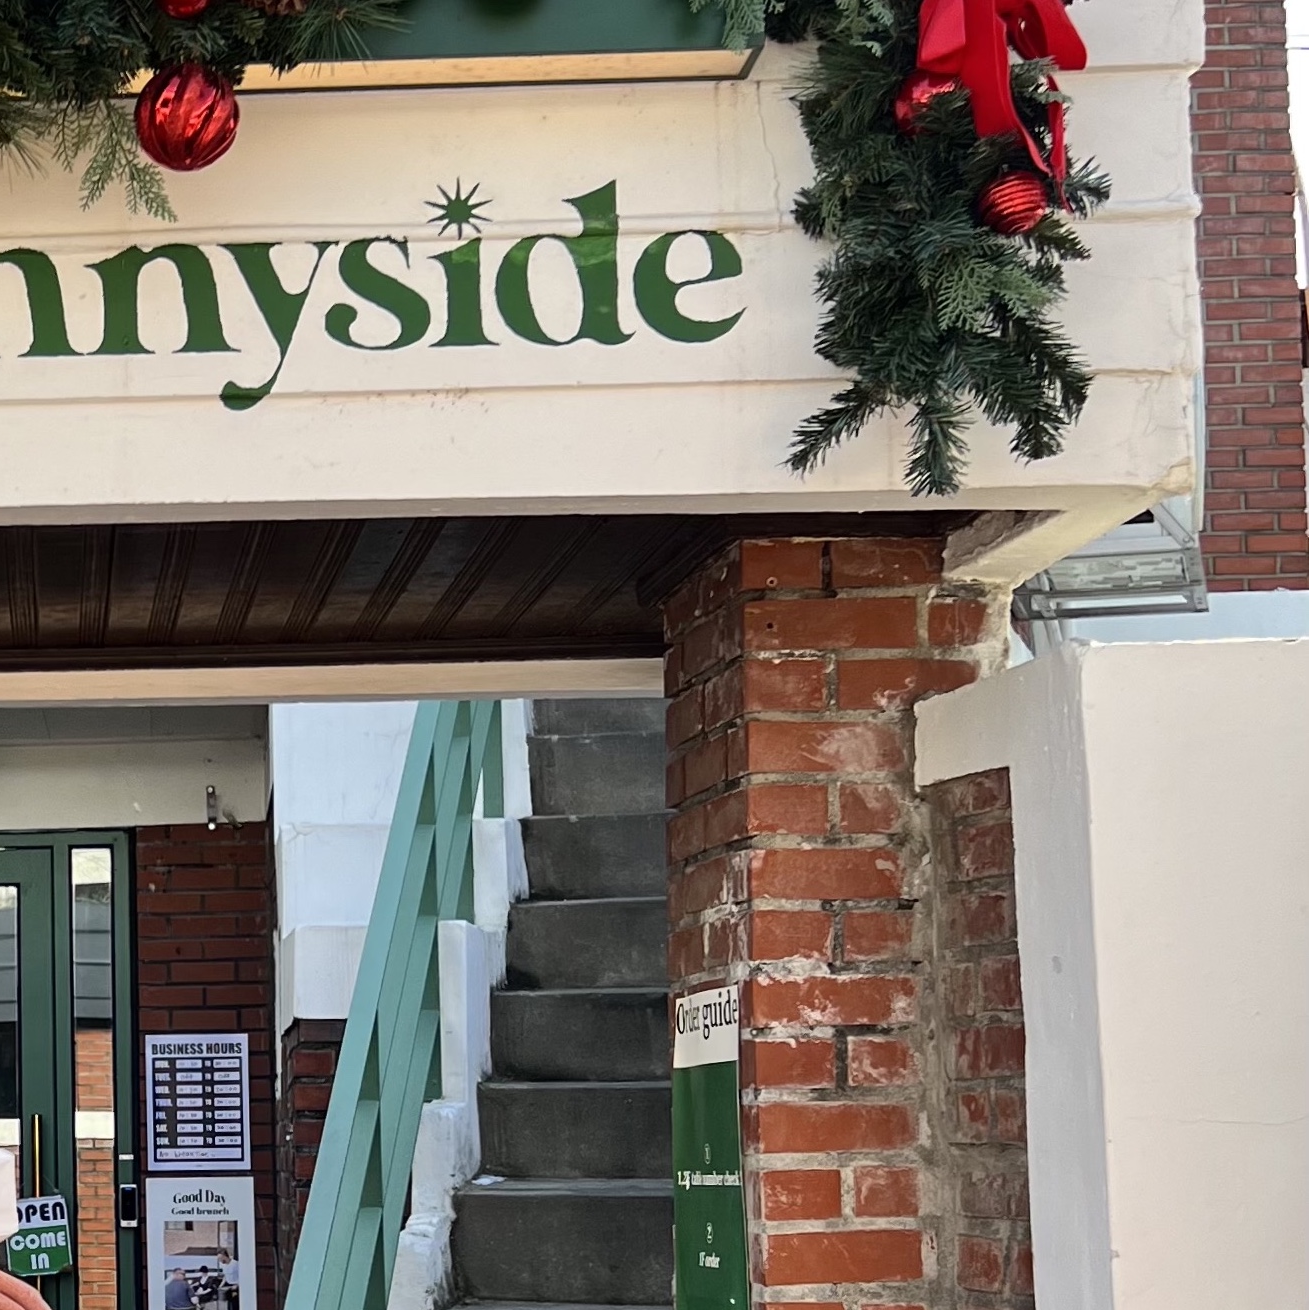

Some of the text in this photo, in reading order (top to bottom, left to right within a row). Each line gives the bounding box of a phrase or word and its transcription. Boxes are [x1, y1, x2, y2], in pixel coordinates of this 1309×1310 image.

[702, 989, 738, 1040] guide
[151, 1042, 242, 1055] BUSINESS HOURS
[172, 1188, 226, 1207] Good Day
[171, 1207, 194, 1215] Good
[10, 1231, 66, 1251] COME
[30, 1253, 50, 1270] IN
